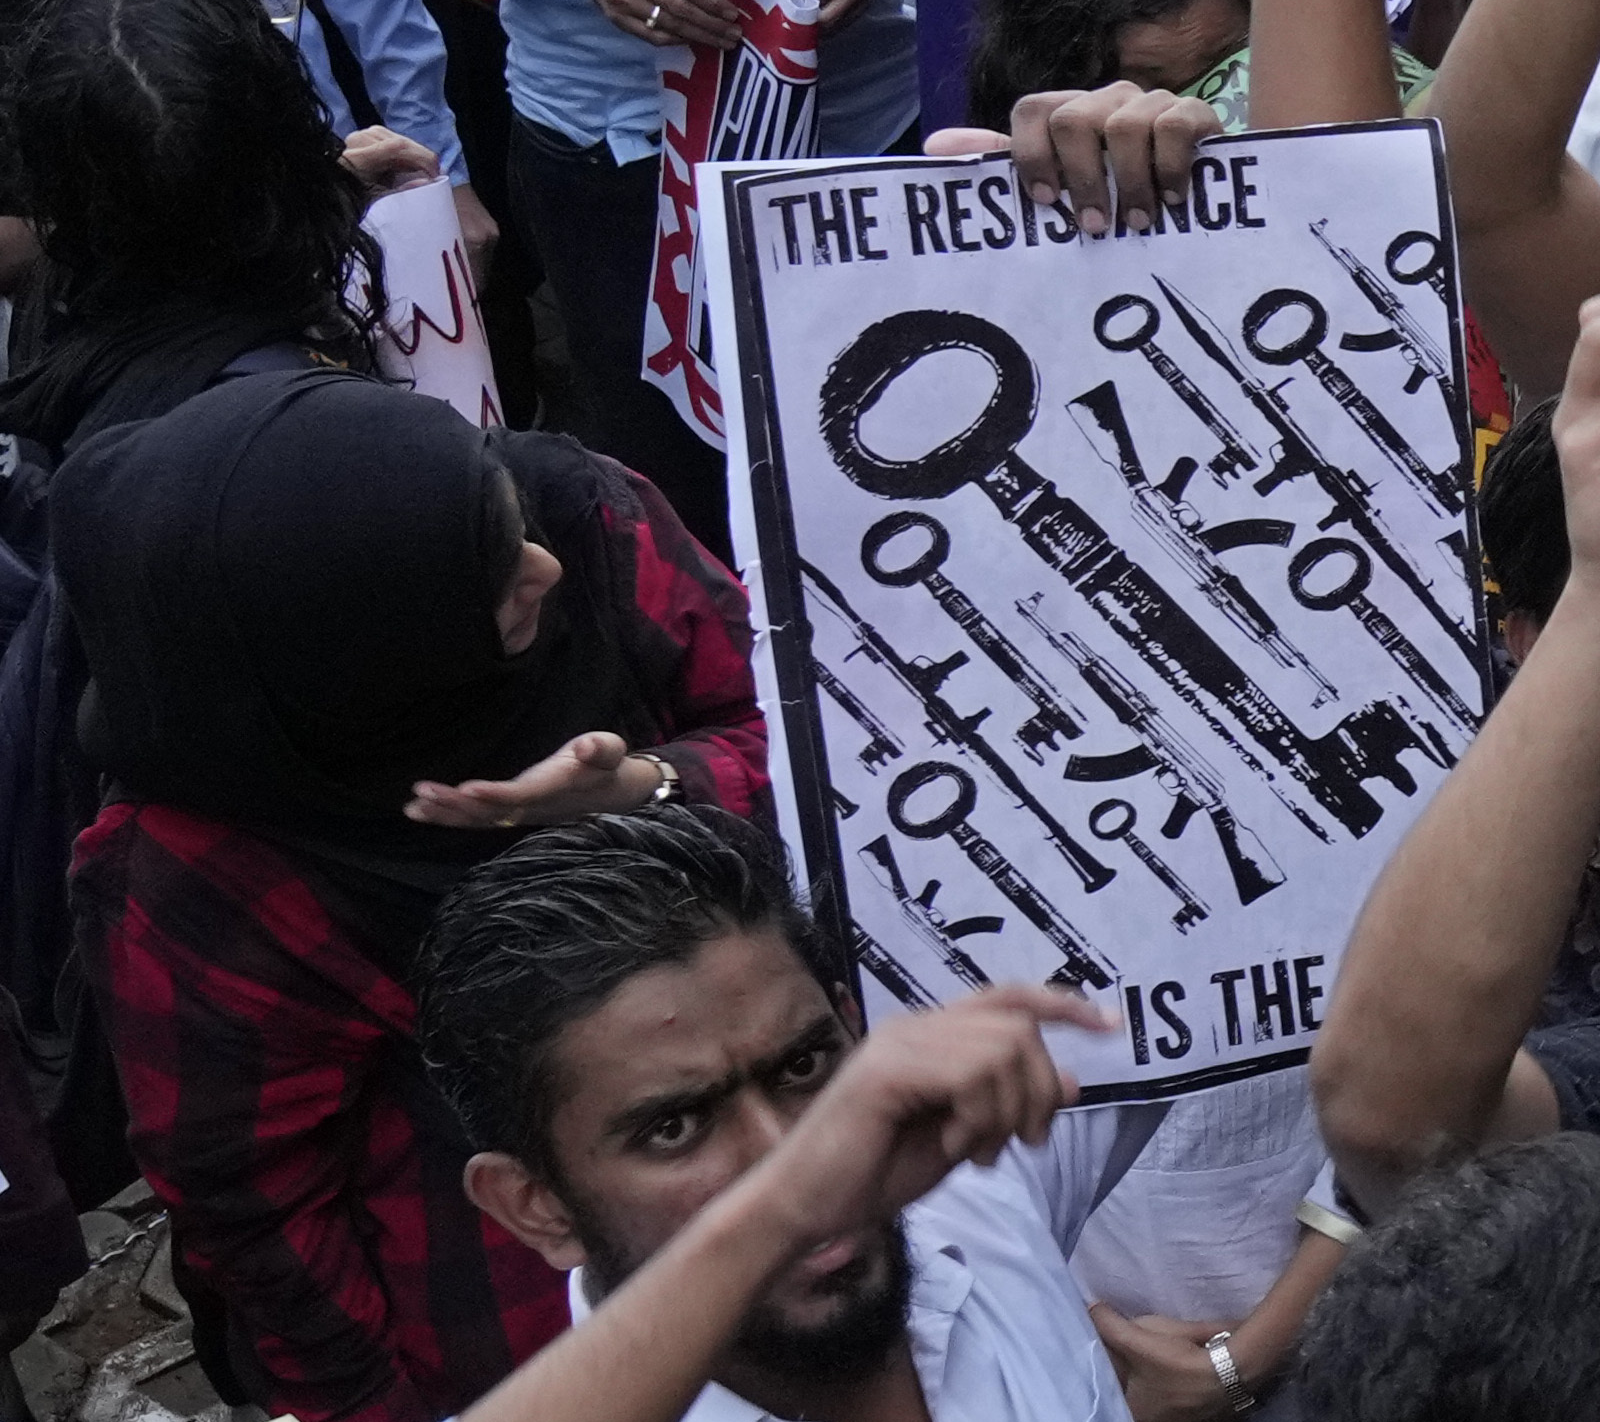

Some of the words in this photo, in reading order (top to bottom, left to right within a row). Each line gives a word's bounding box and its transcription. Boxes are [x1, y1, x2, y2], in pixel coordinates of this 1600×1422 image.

[768, 184, 889, 268] THE
[1122, 979, 1194, 1067] IS
[1209, 953, 1327, 1047] THE
